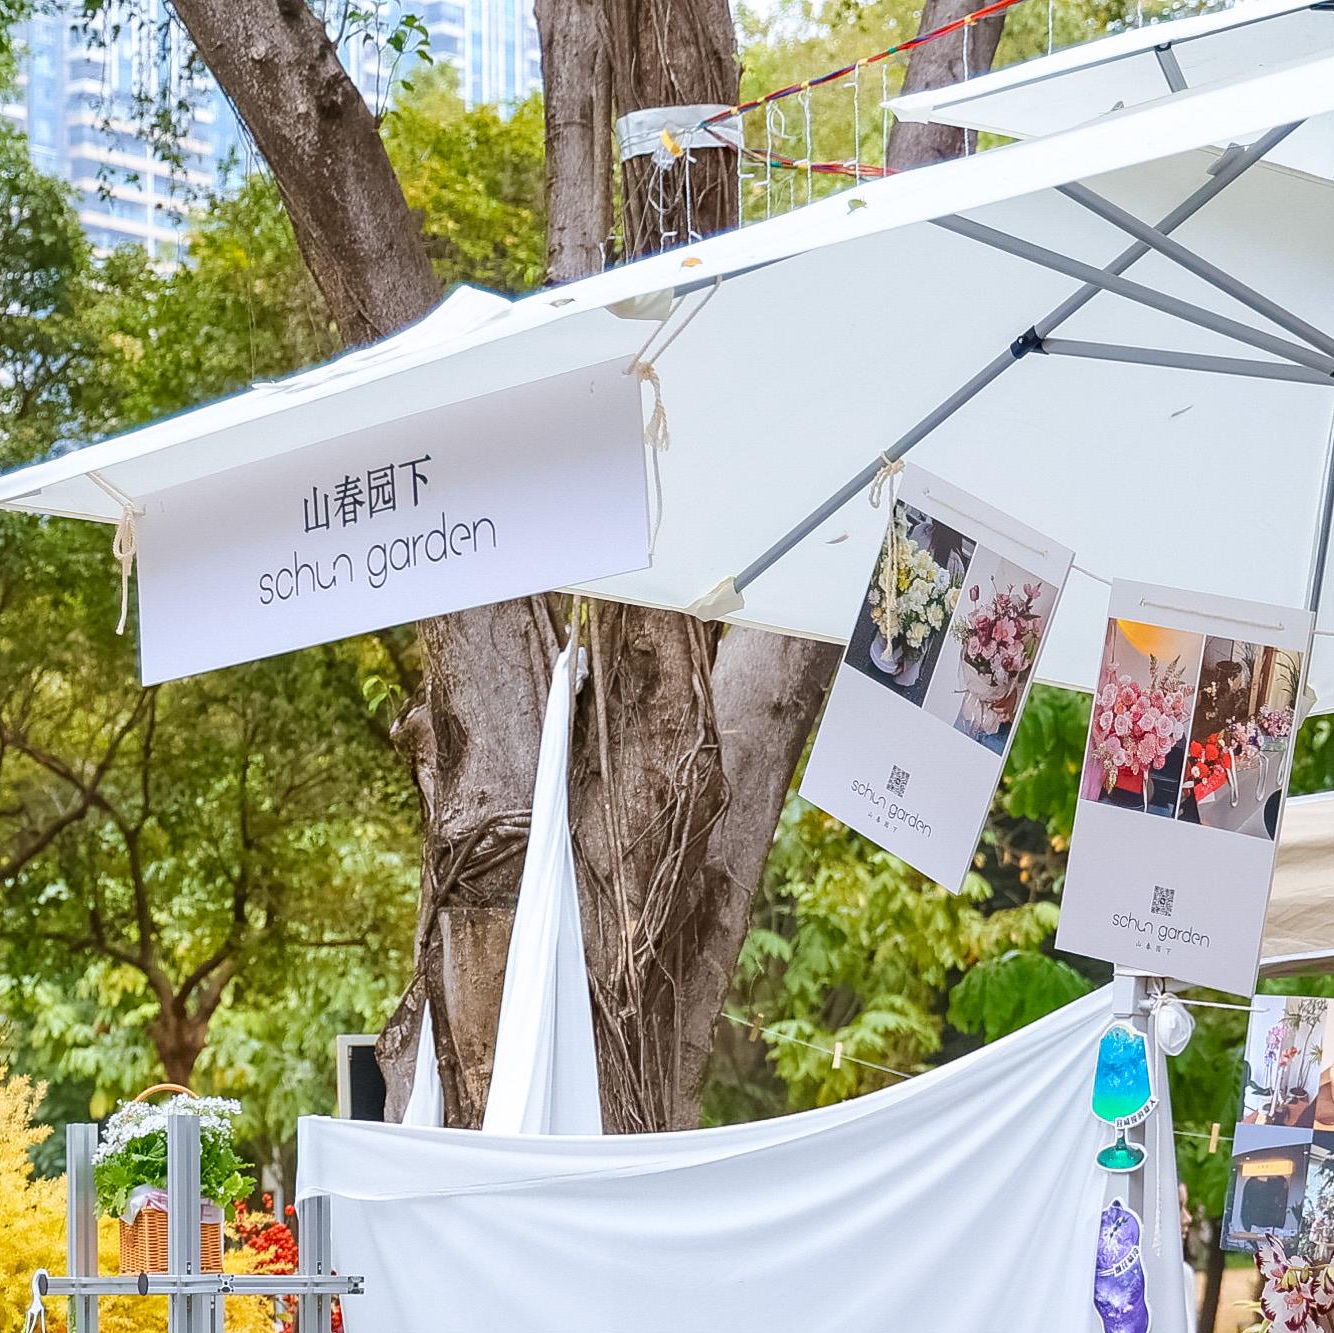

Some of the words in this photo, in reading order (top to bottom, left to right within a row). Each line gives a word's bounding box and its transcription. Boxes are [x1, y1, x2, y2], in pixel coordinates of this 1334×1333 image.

[304, 455, 432, 534] 山春园下
[259, 551, 353, 606] schun
[367, 512, 497, 588] garden
[851, 780, 886, 809] schun
[888, 804, 931, 838] garden
[1112, 912, 1153, 935] schun
[1158, 926, 1210, 949] garden
